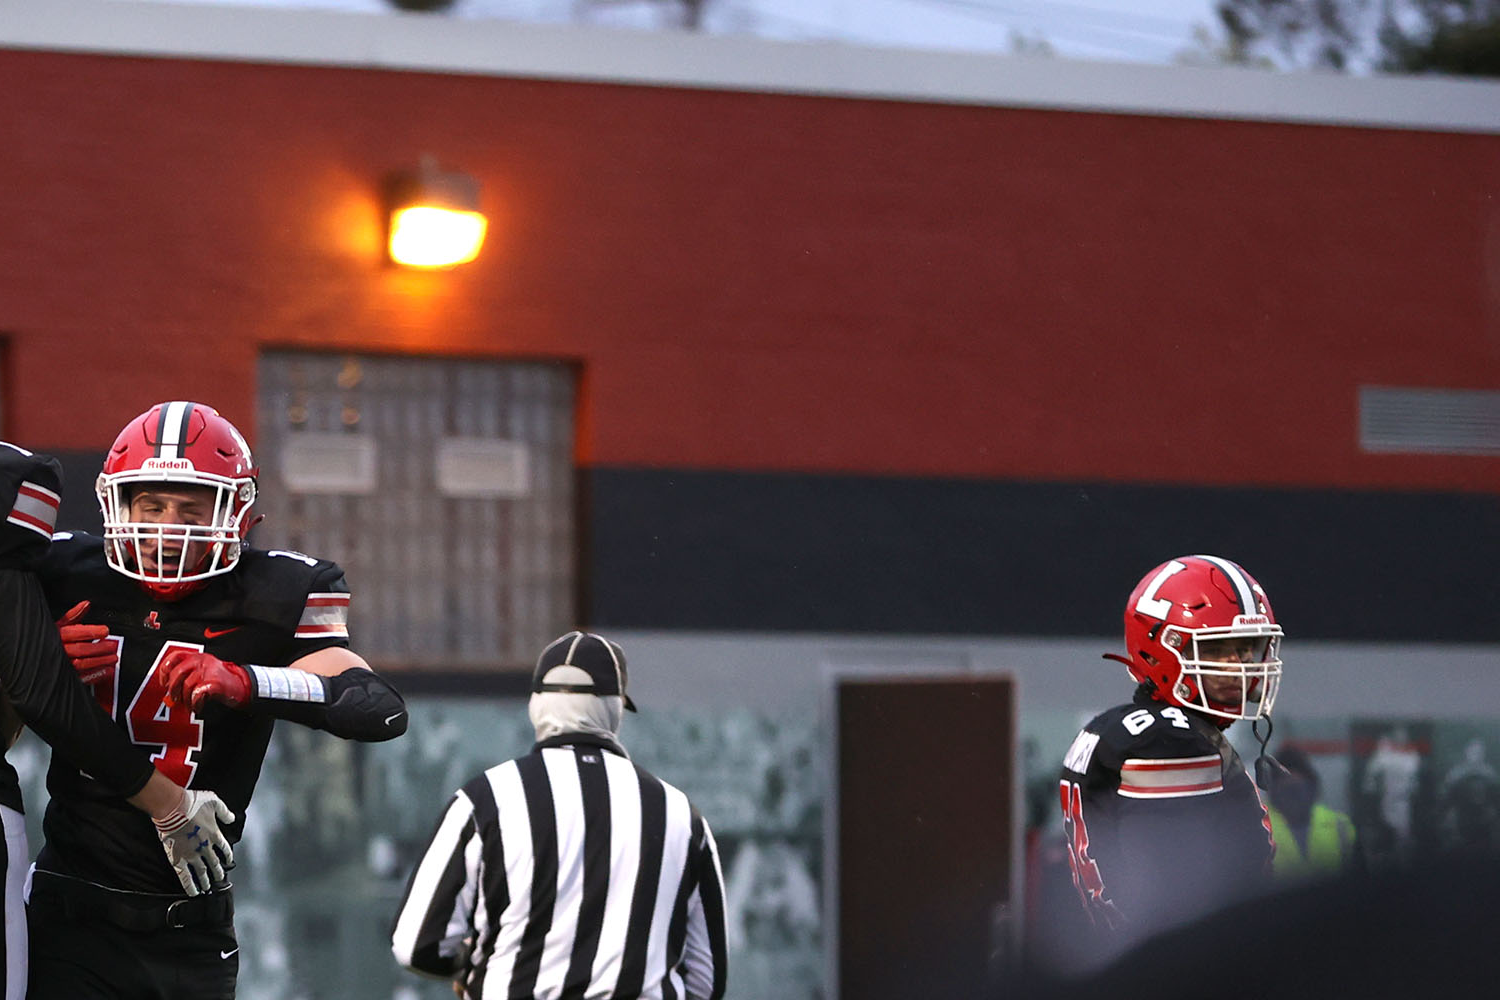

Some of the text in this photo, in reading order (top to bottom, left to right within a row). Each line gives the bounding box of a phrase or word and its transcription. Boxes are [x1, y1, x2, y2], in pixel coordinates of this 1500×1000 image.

[148, 460, 188, 469] Riddell
[1135, 560, 1187, 621] L
[1239, 617, 1267, 625] Riddell
[1122, 706, 1191, 736] 64
